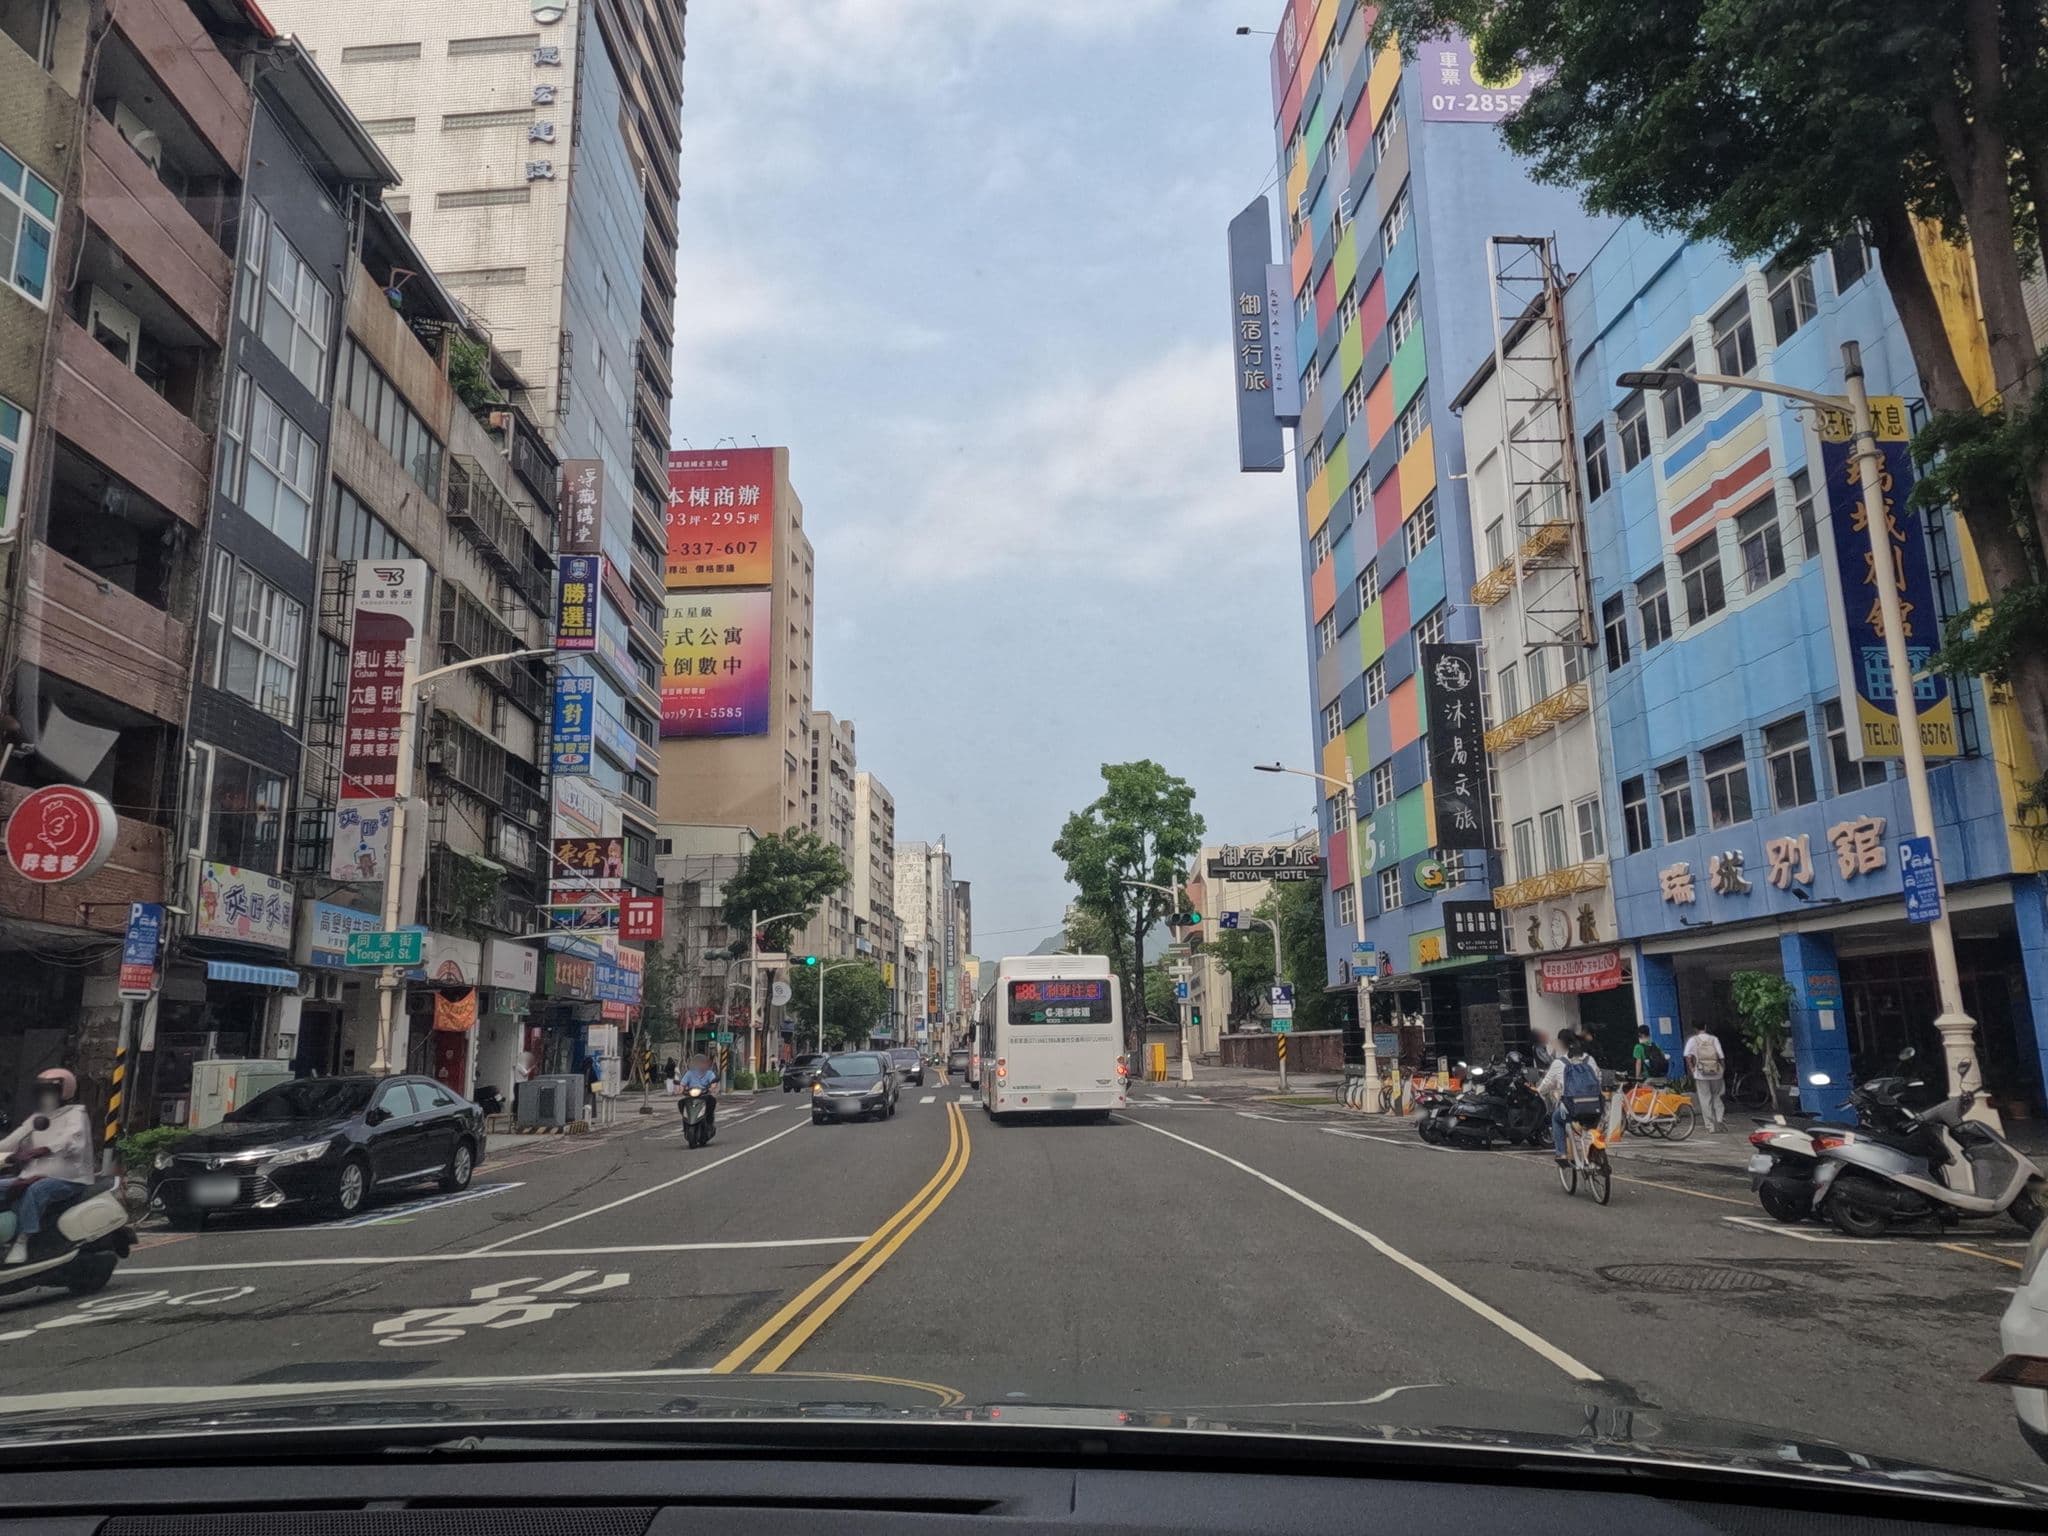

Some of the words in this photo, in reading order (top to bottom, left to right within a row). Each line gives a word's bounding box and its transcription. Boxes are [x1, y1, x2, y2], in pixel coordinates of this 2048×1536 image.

[1239, 291, 1266, 391] 御宿行旅
[667, 484, 760, 508] 本棟商辦
[1221, 844, 1314, 866] 御宿行旅
[1229, 871, 1264, 880] ROYAL
[1275, 871, 1309, 880] HOTEL
[357, 934, 411, 948] 同愛街
[357, 949, 394, 962] Tong-ai
